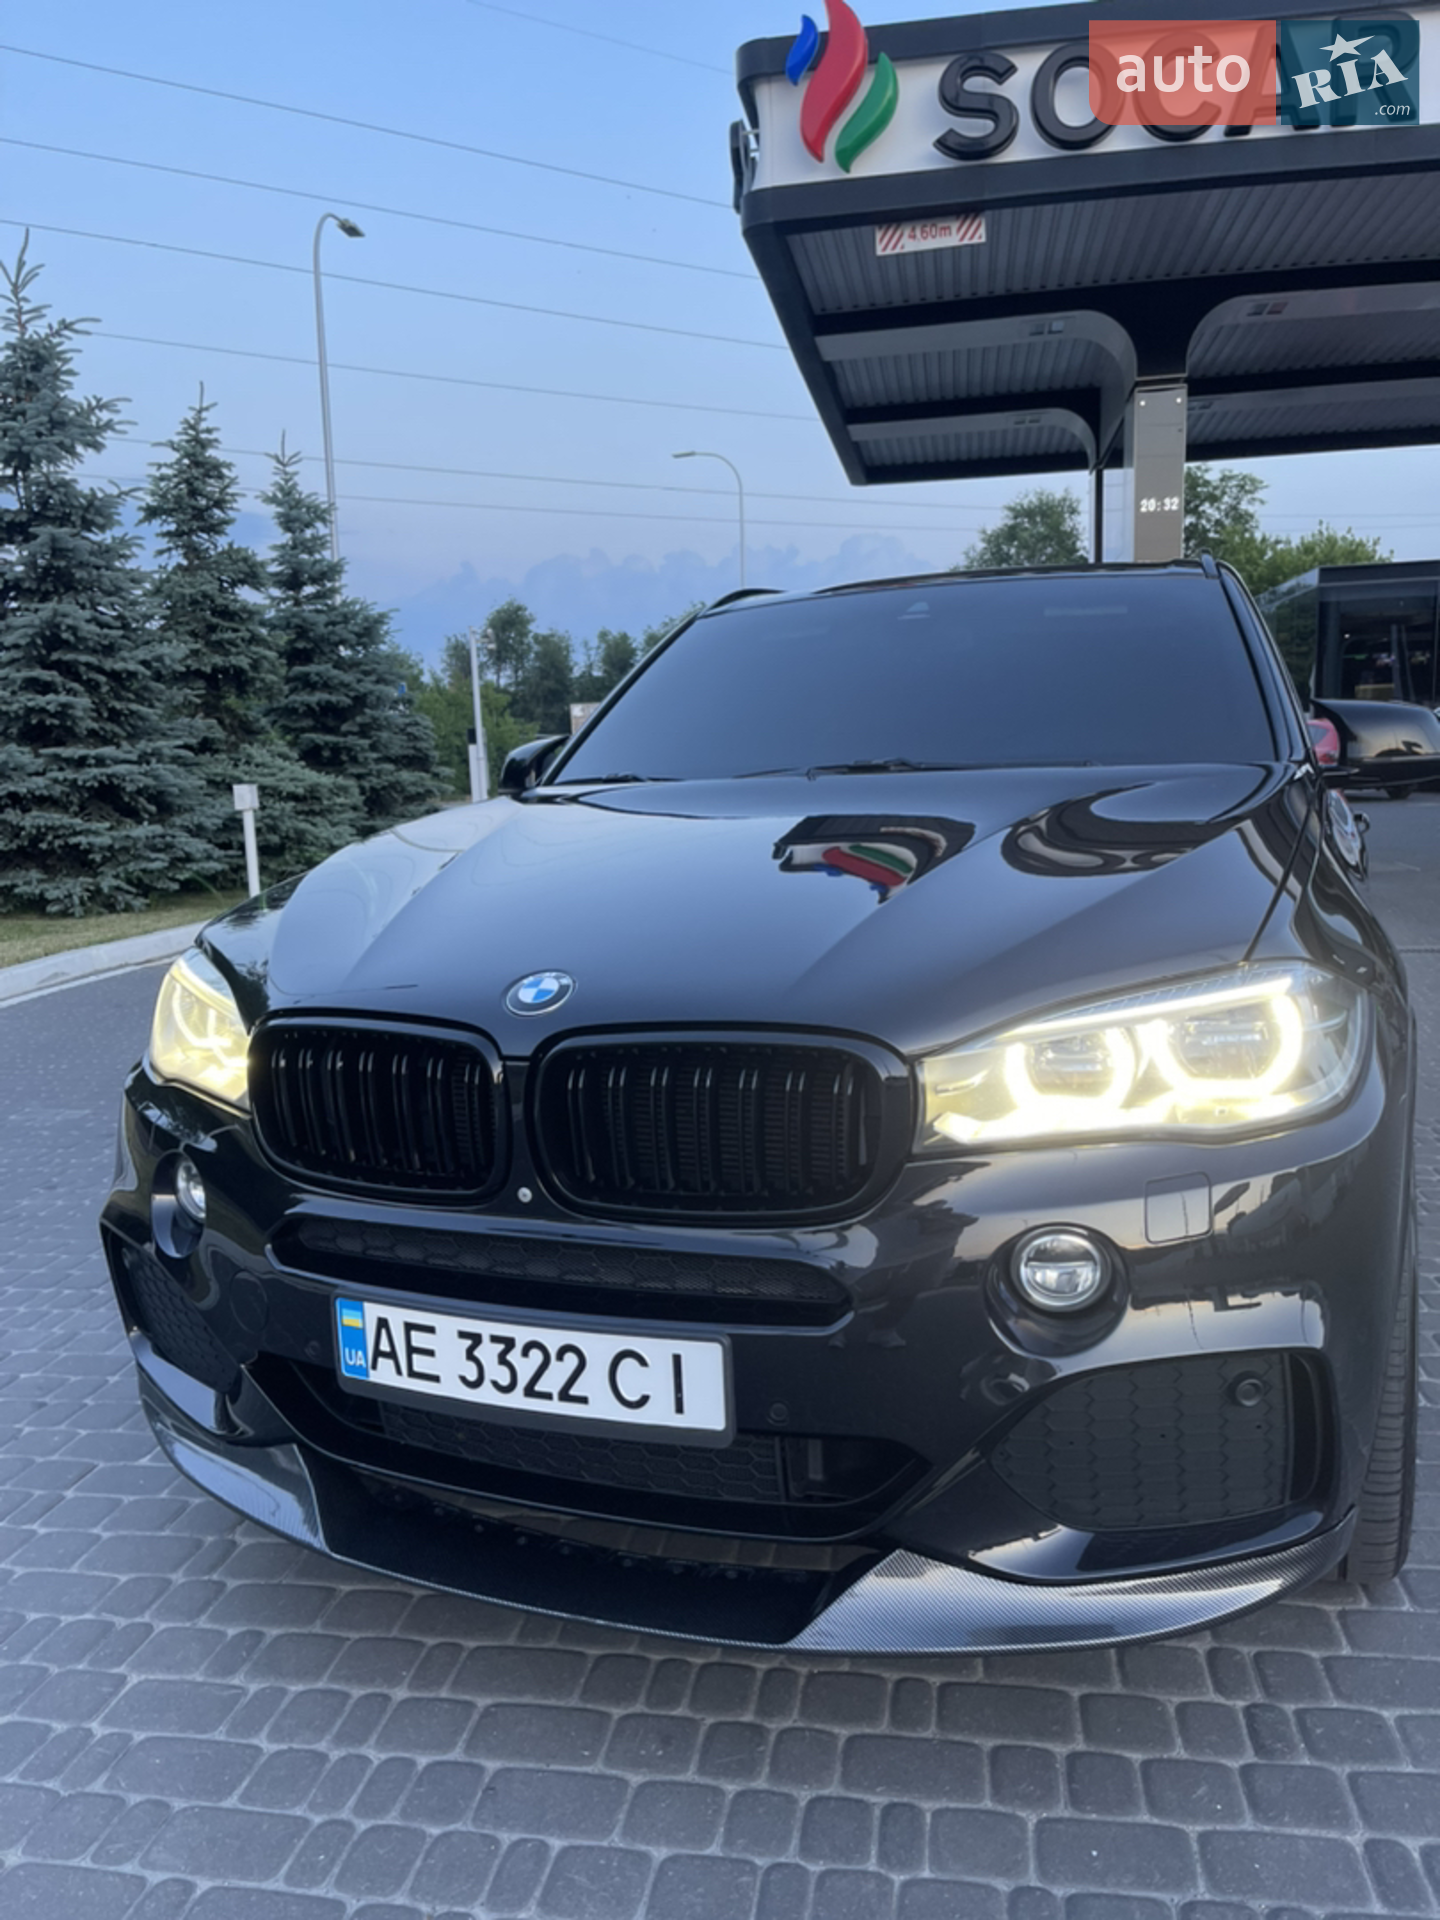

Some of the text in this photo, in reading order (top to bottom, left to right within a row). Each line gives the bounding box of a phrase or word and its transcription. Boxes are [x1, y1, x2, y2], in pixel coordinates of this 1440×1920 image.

[345, 1347, 367, 1368] UA
[370, 1316, 441, 1384] AE
[457, 1330, 589, 1405] 3322
